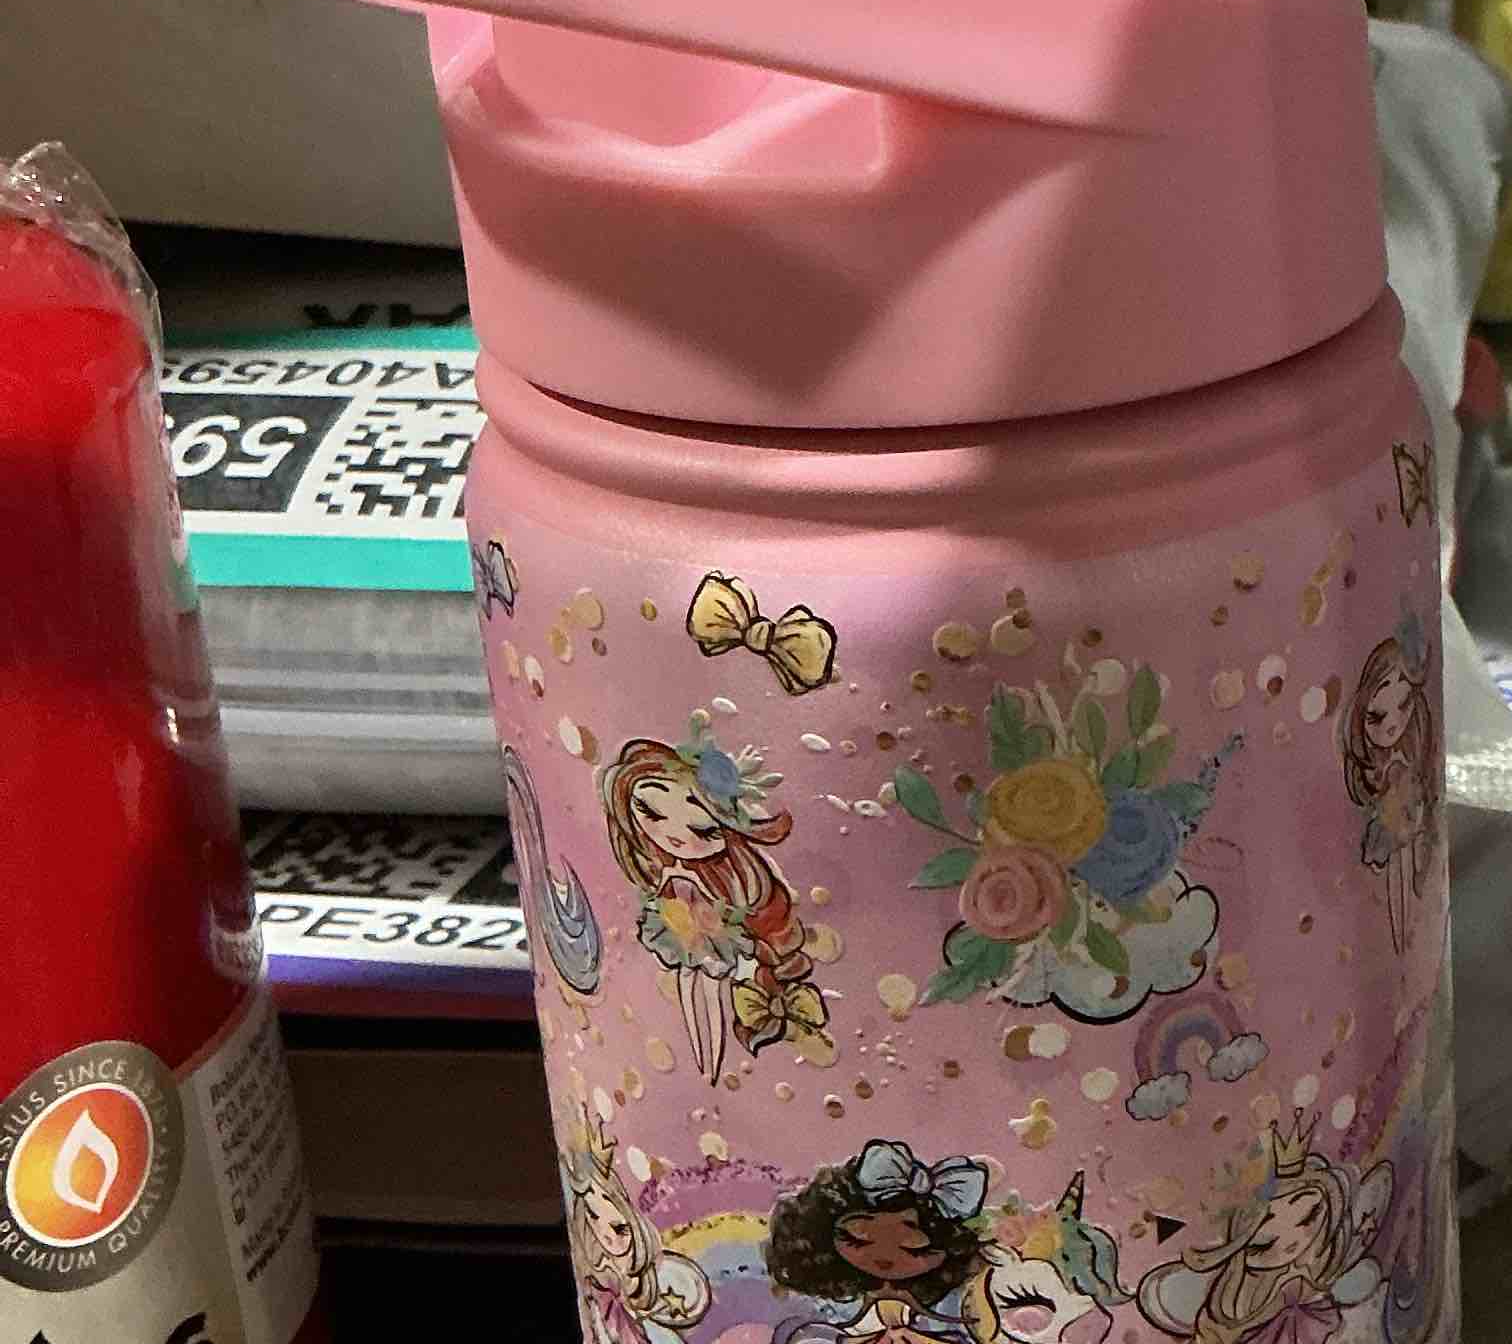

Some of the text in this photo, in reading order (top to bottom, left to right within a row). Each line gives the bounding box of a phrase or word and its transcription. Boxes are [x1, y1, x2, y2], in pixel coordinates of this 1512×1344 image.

[258, 904, 529, 951] PE382
[54, 1058, 128, 1093] SINCE
[0, 1219, 97, 1273] PREMIUM
